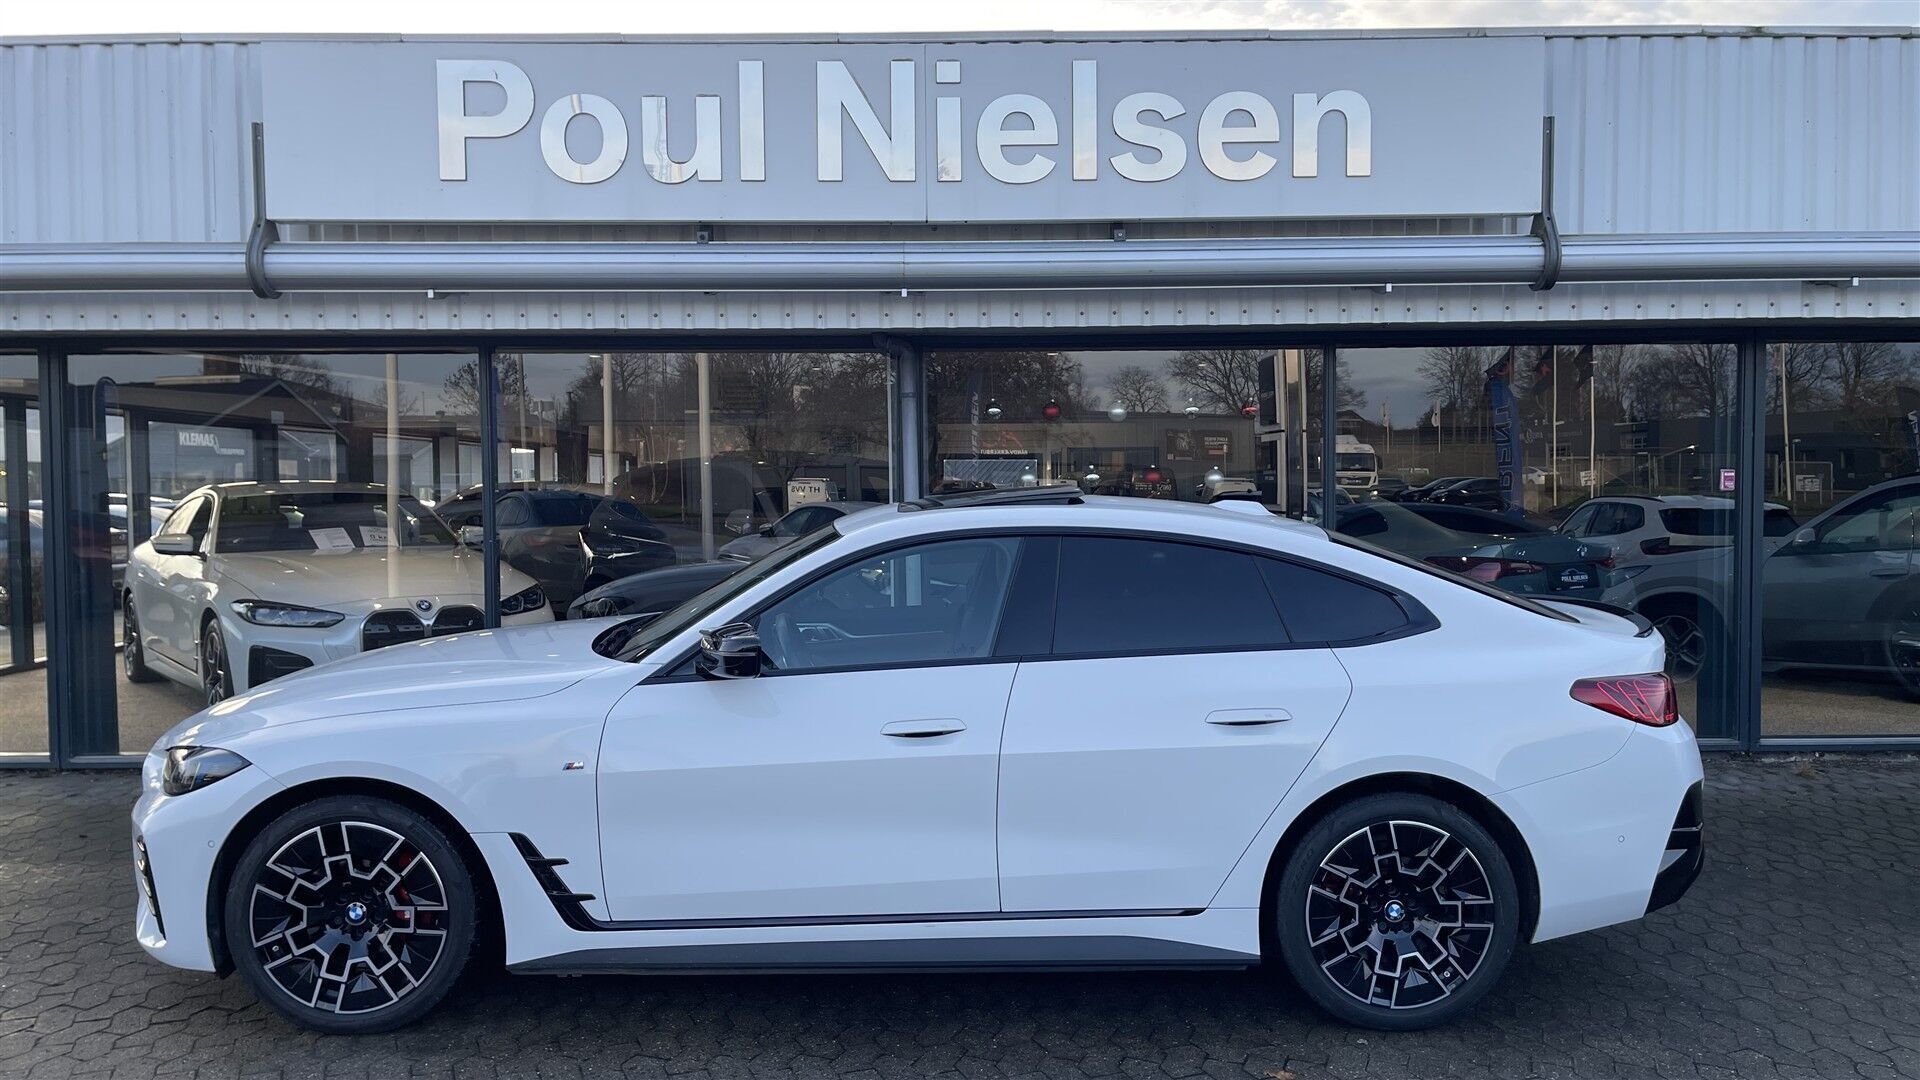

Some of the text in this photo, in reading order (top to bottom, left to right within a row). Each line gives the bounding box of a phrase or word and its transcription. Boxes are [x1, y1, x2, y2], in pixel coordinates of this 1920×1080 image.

[437, 59, 1372, 183] Poul Nielsen
[179, 432, 214, 446] KLEMAS
